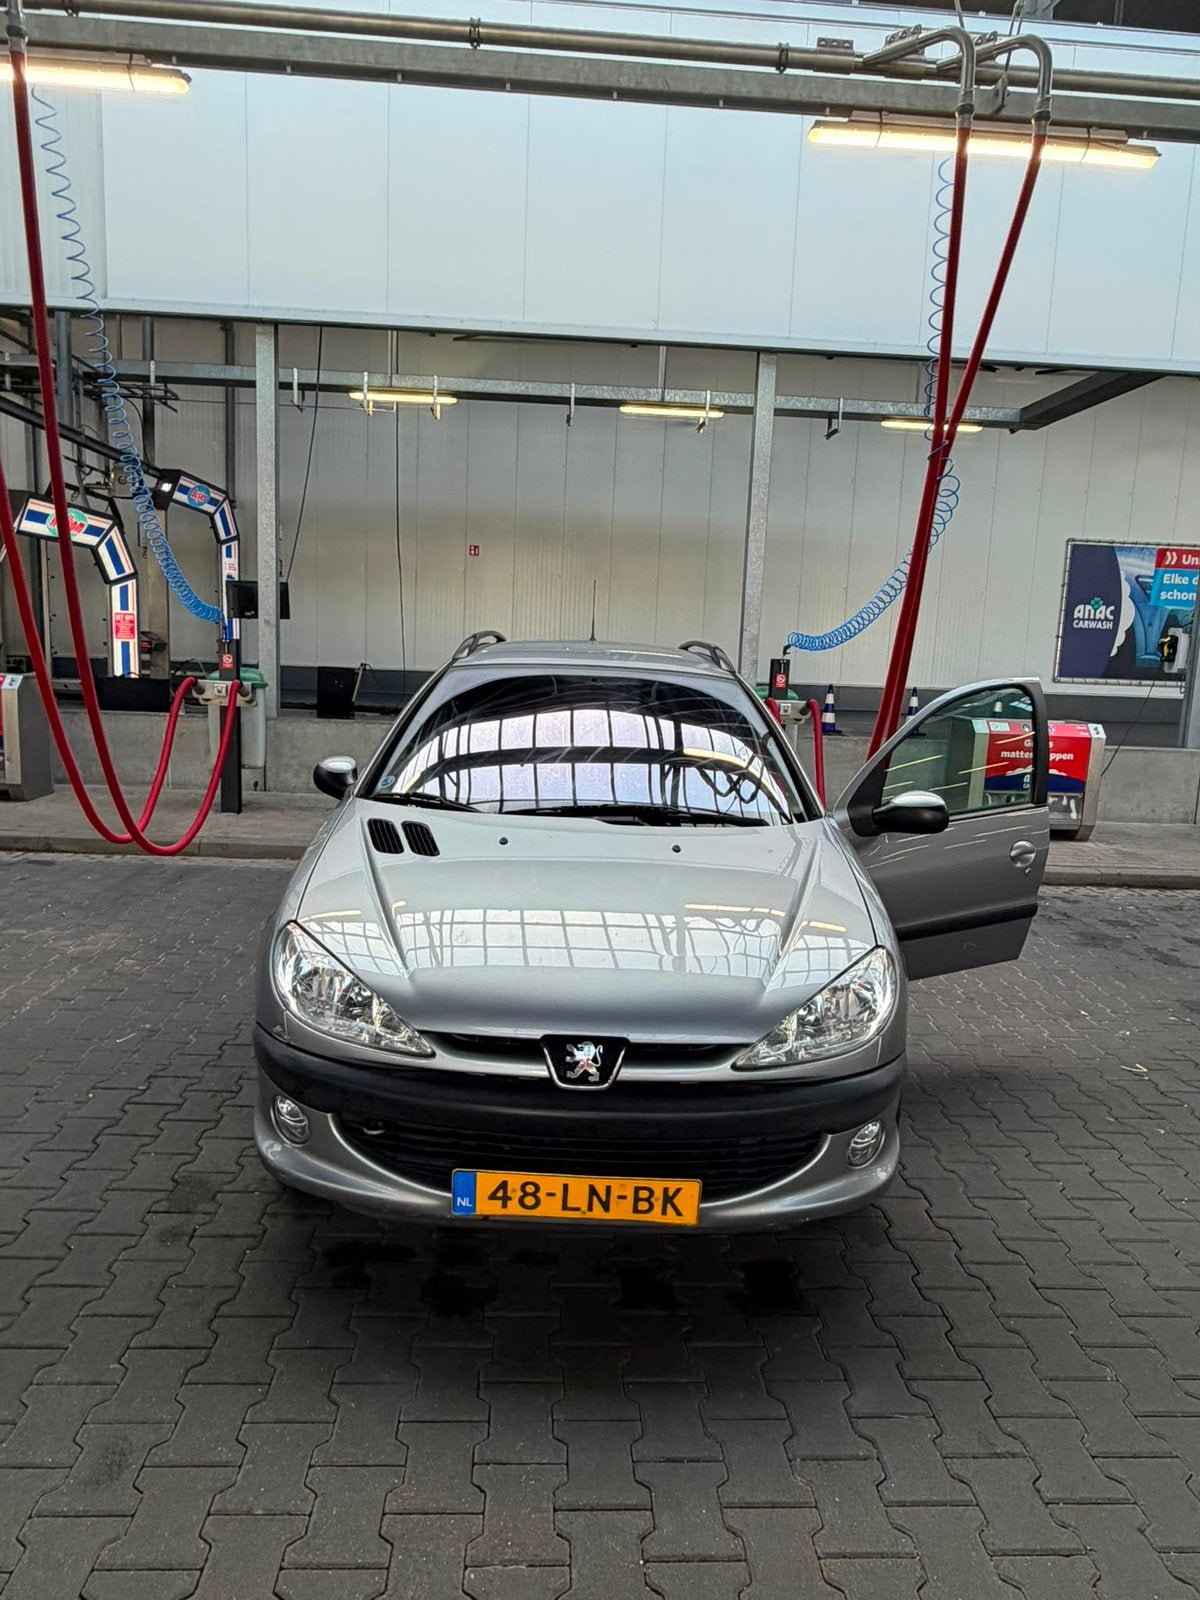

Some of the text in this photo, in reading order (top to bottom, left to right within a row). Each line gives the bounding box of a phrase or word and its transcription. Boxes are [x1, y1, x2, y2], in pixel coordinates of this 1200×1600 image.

[1163, 574, 1189, 585] Elke
[1073, 619, 1113, 630] CARWASH
[456, 1197, 473, 1207] NL
[488, 1180, 683, 1216] 48-LN-BK
